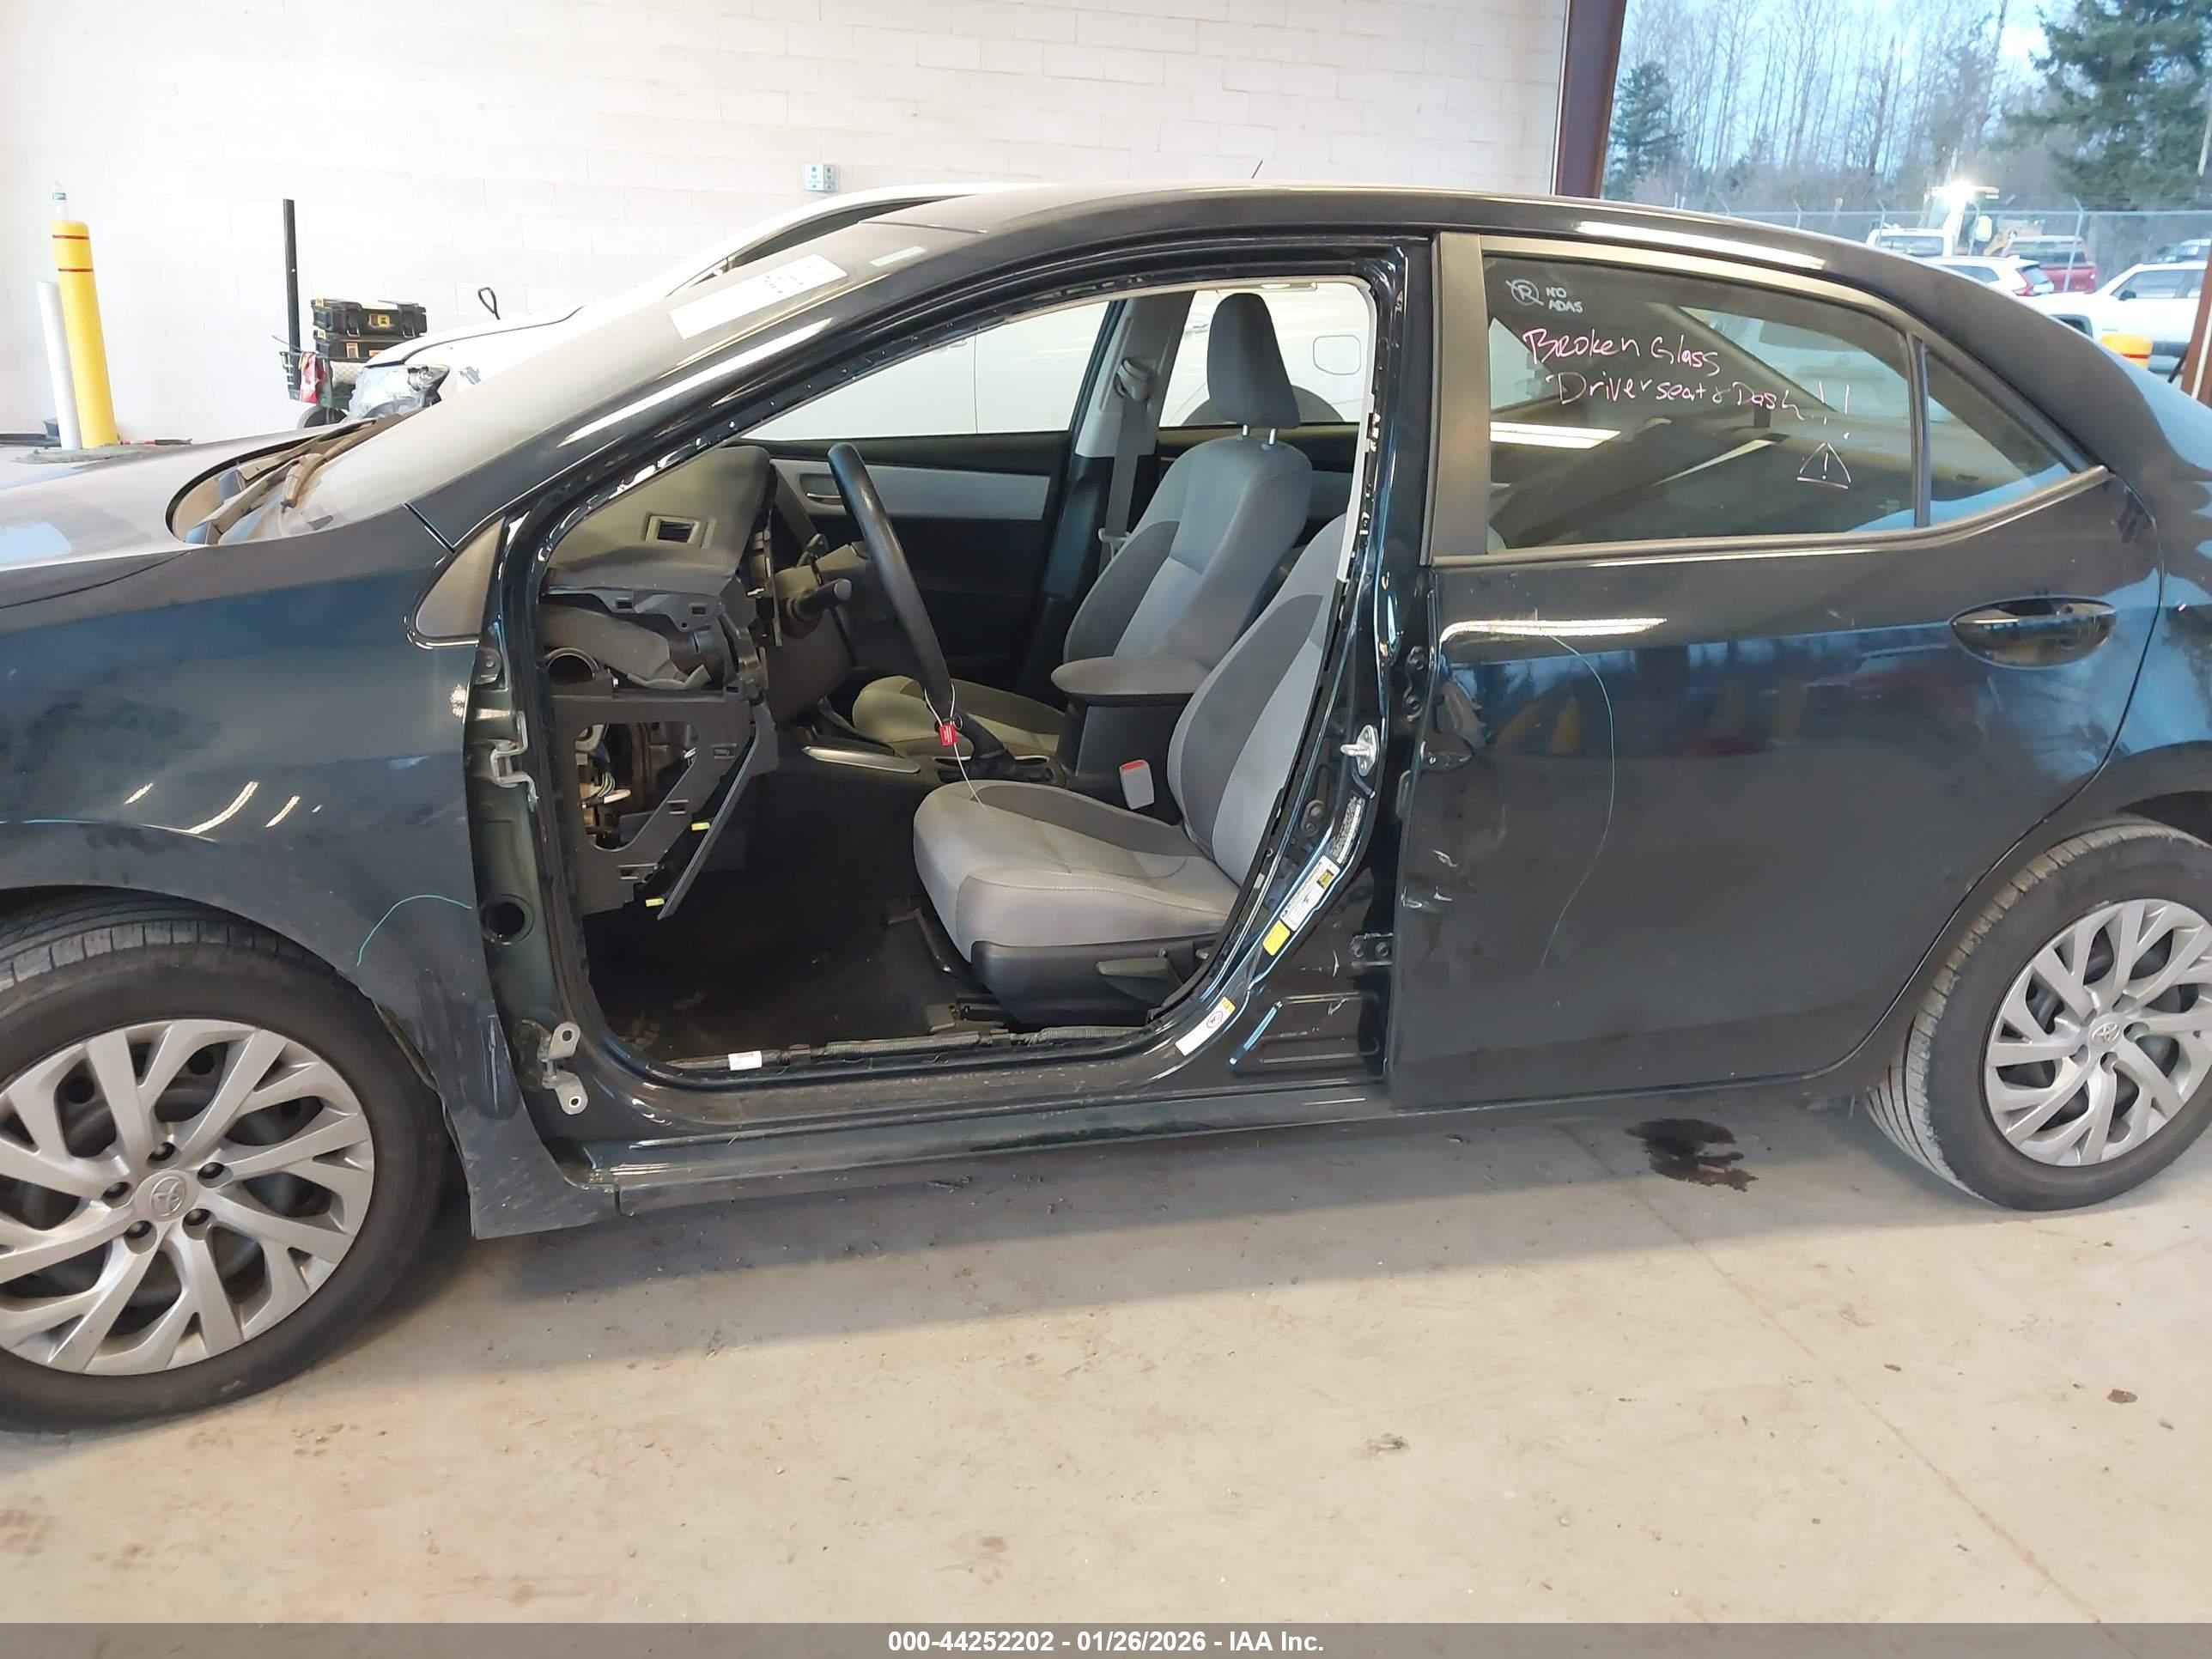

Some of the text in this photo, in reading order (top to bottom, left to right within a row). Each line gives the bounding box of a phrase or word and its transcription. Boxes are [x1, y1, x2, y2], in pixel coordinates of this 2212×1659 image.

[1546, 287, 1567, 299] NO
[1548, 300, 1583, 313] ADAS
[1650, 334, 1721, 377] Glass
[1546, 371, 1652, 405] Driver
[1656, 380, 1707, 403] seat
